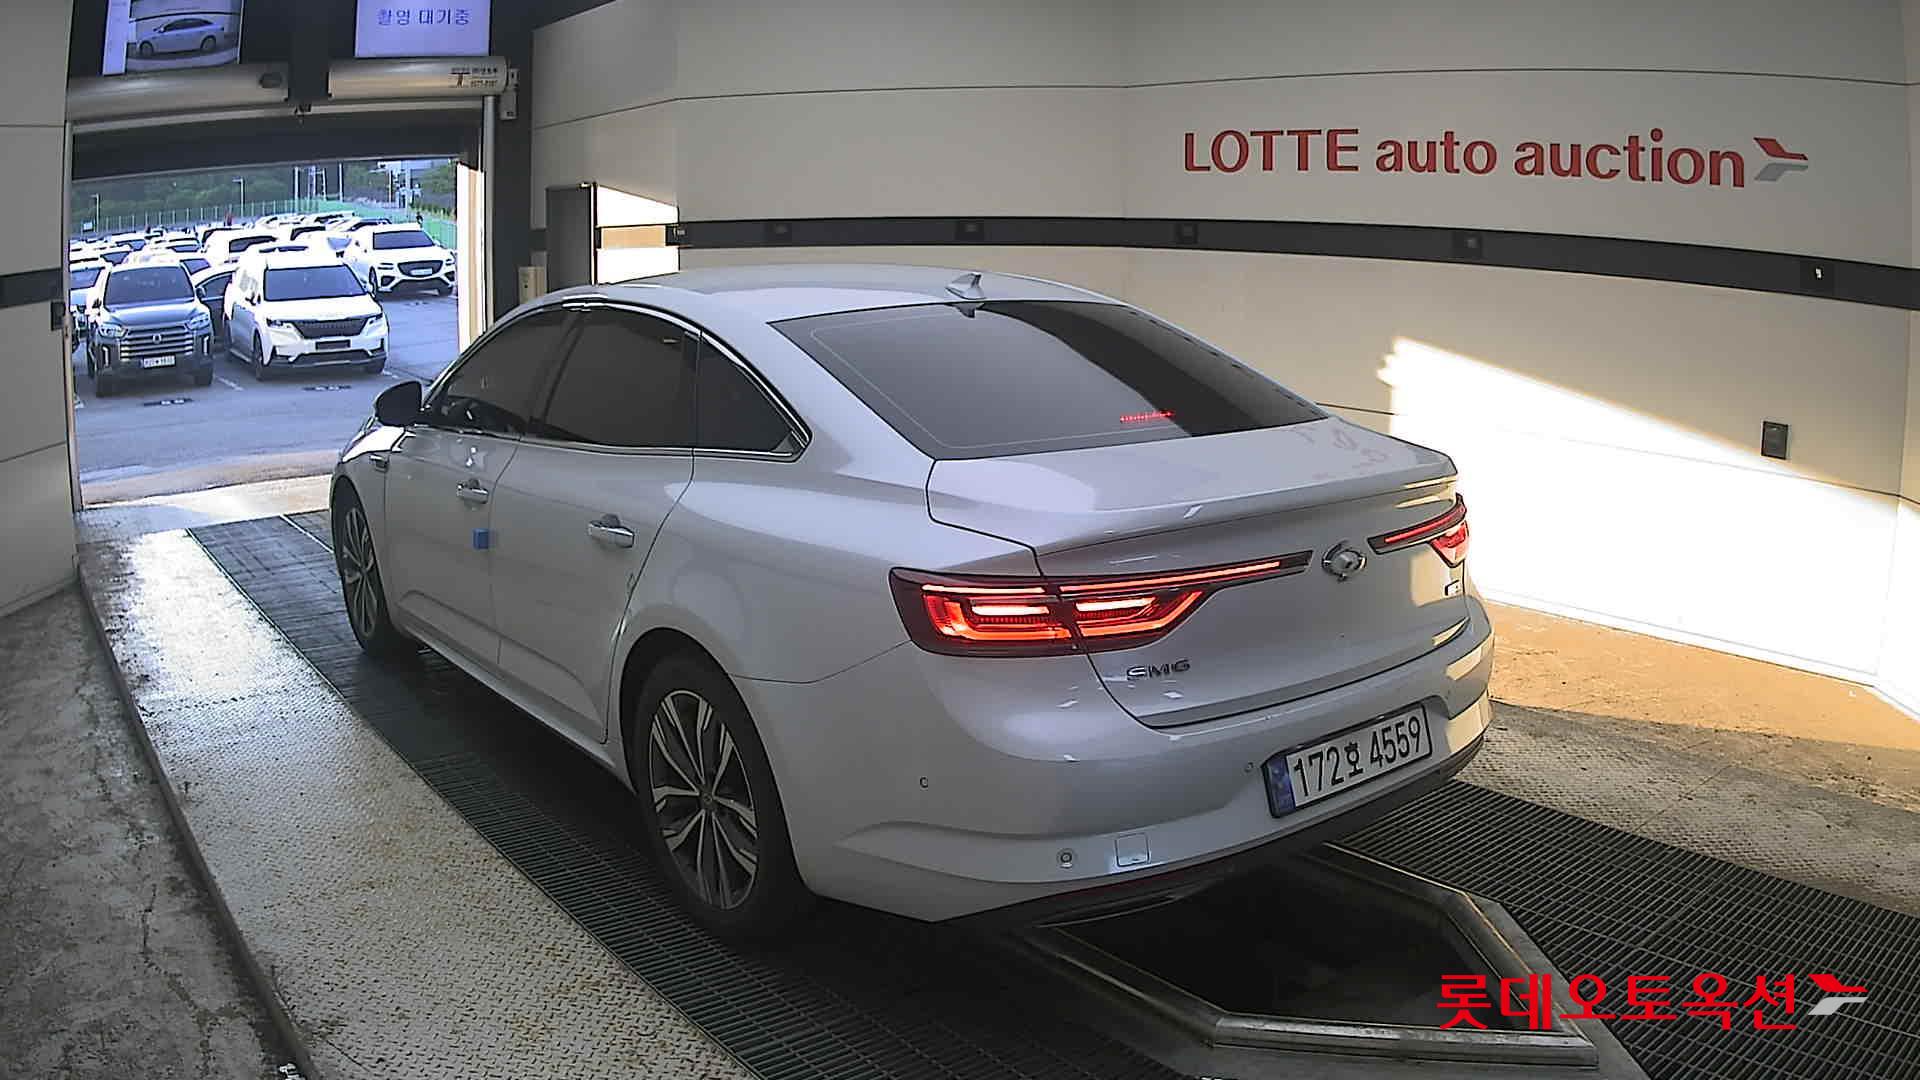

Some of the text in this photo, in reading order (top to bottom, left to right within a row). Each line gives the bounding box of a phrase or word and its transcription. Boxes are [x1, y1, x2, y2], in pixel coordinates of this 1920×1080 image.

[419, 8, 470, 26] 대기중
[1183, 127, 1746, 188] LOTTE auto auction
[1293, 716, 1421, 797] 172호 4559
